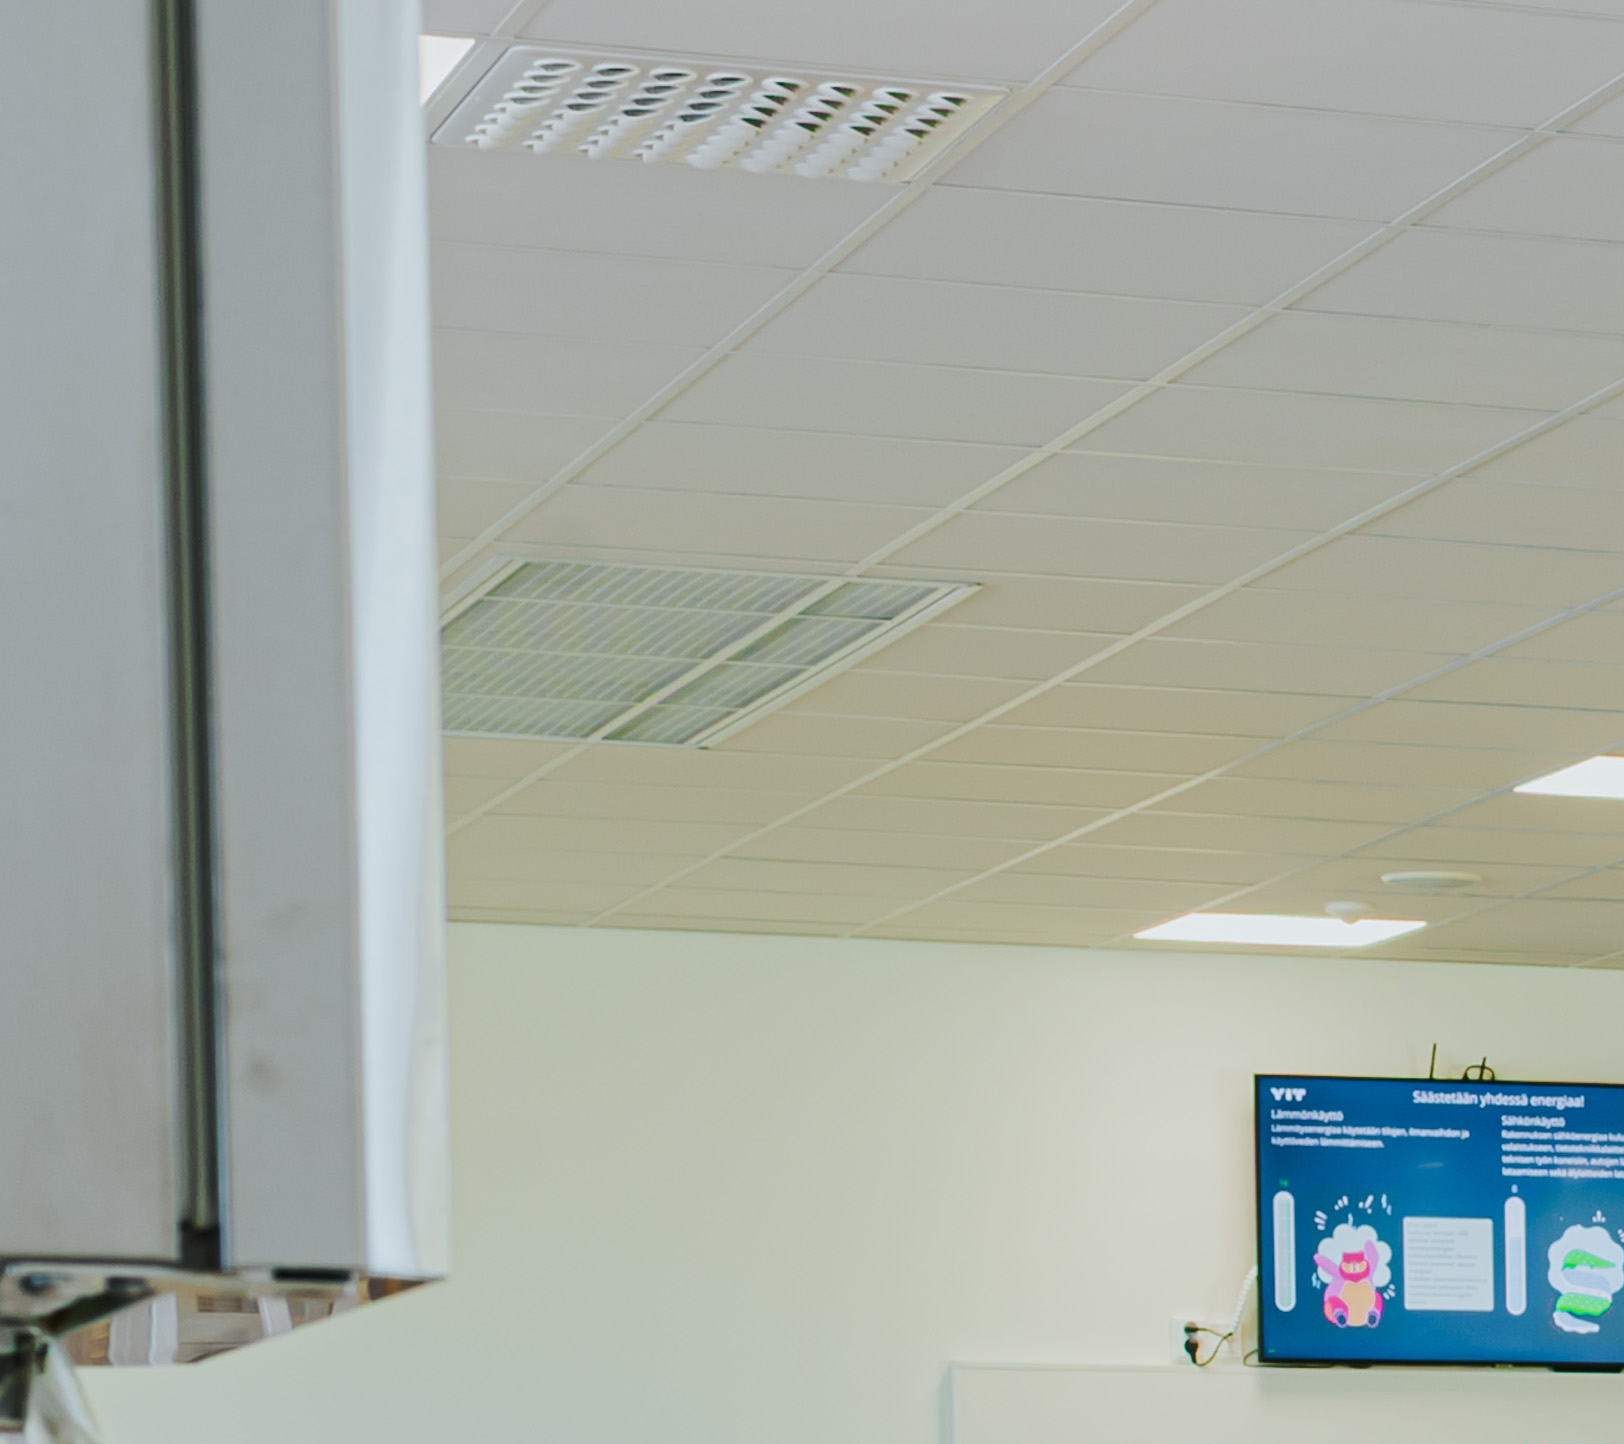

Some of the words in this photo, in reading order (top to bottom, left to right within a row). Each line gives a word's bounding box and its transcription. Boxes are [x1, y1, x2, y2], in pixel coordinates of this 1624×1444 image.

[1270, 1088, 1306, 1101] YIT
[1413, 1090, 1478, 1105] Säästetään
[1479, 1092, 1528, 1108] yhdessä
[1530, 1094, 1585, 1110] energiaa!
